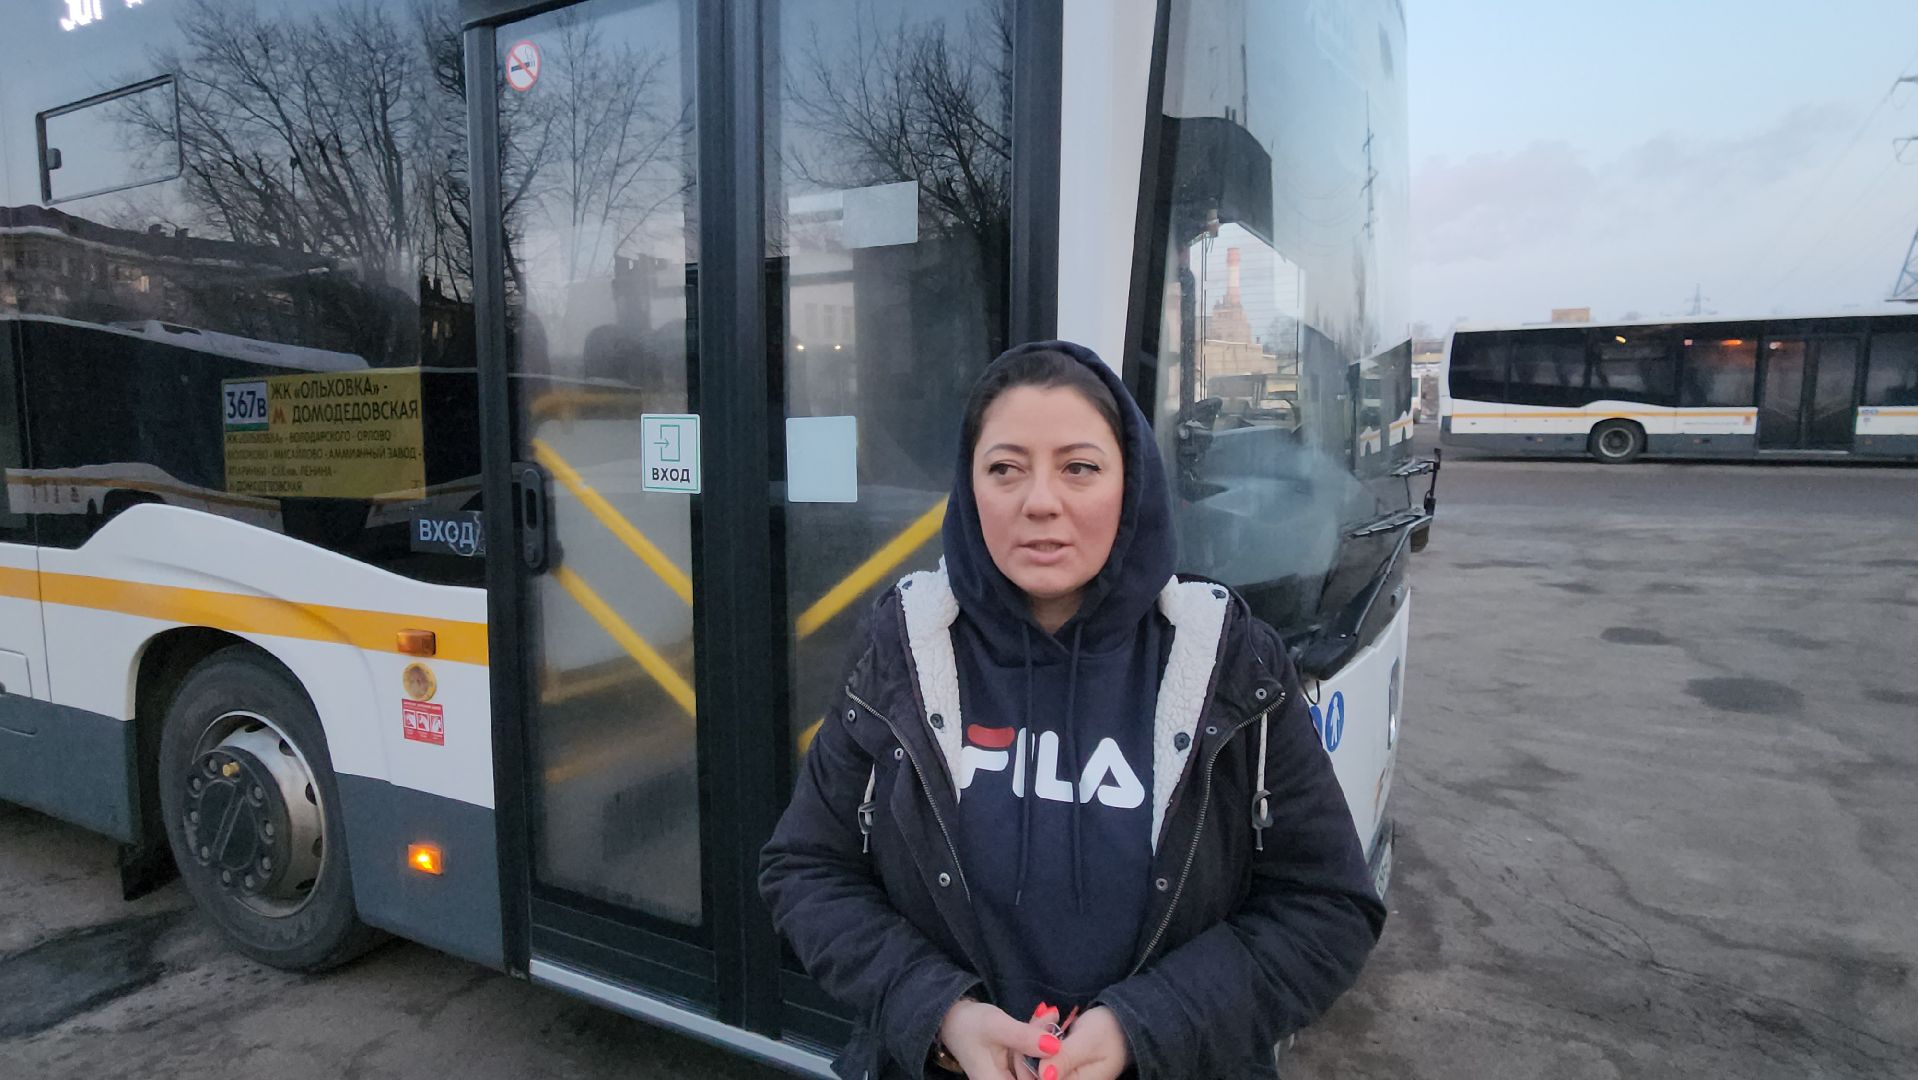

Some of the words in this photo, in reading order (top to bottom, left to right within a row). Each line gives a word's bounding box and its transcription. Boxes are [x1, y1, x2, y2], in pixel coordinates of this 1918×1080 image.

[271, 383, 292, 399] ЖК
[294, 377, 380, 399] «ОЛЬХОВКА»
[292, 400, 419, 424] ДОМОДЕДОВСКАЯ
[357, 430, 392, 442] ОРЛОВО
[387, 447, 416, 461] ЗАВОД
[651, 467, 690, 483] ВХОД
[419, 519, 475, 549] ВХОД
[959, 723, 1145, 809] FILA
